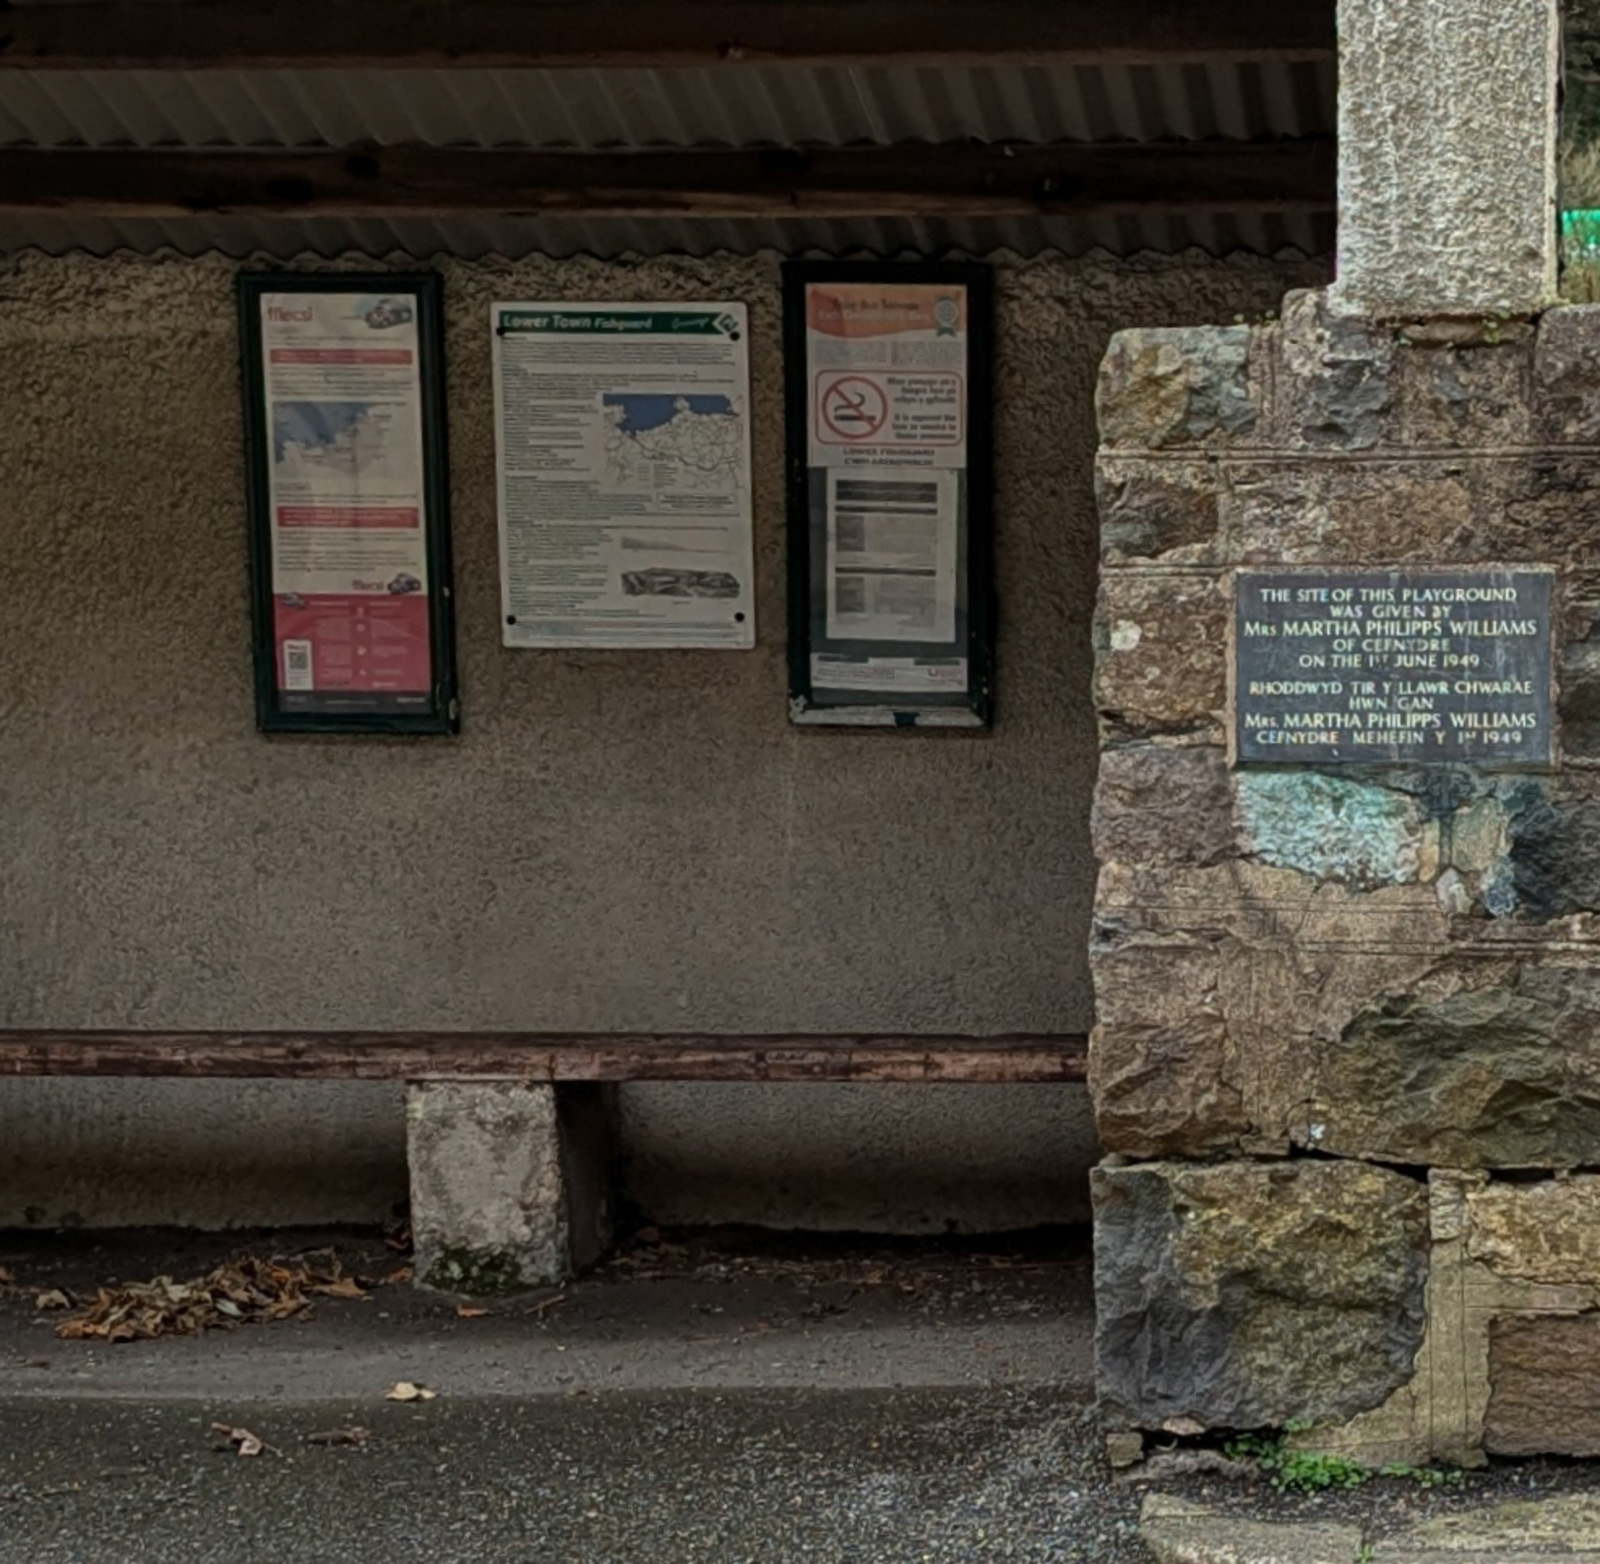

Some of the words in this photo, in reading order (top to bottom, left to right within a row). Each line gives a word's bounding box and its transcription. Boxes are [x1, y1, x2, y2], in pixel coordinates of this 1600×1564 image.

[503, 314, 550, 328] Lower
[552, 314, 591, 329] Town
[1260, 588, 1290, 602] THE
[1296, 588, 1329, 602] SITE
[1331, 588, 1354, 602] OF
[1359, 588, 1395, 602] THIS
[1402, 588, 1517, 601] PLAYGROUND
[1329, 605, 1363, 619] WAS
[1372, 605, 1427, 618] GIVEN
[1431, 605, 1452, 618] BY
[1281, 620, 1361, 636] MARTHA
[1365, 620, 1442, 636] PHILIPPS
[1449, 620, 1537, 636] WILLIAMS
[1332, 638, 1356, 652] OF
[1361, 638, 1450, 652] CEFNYDRE
[1298, 654, 1326, 668] ON
[1331, 654, 1362, 668] THE
[1393, 654, 1437, 668] JUNE
[1443, 653, 1480, 668] 1949
[1249, 681, 1343, 696] RHODDWYD
[1350, 681, 1376, 695] TIR
[1381, 681, 1393, 695] Y
[1398, 681, 1450, 695] LLAWR
[1454, 680, 1533, 694] CHWARAE
[1348, 697, 1388, 710] HWN
[1397, 696, 1434, 710] GAN
[1283, 713, 1362, 728] MARTHA
[1367, 713, 1442, 728] PHILIPPS
[1449, 712, 1537, 728] WILLIAMS
[1256, 730, 1340, 745] CEFNYDRE
[1352, 731, 1425, 744] MEHEFIN
[1434, 731, 1447, 745] Y
[1482, 731, 1523, 744] 1949
